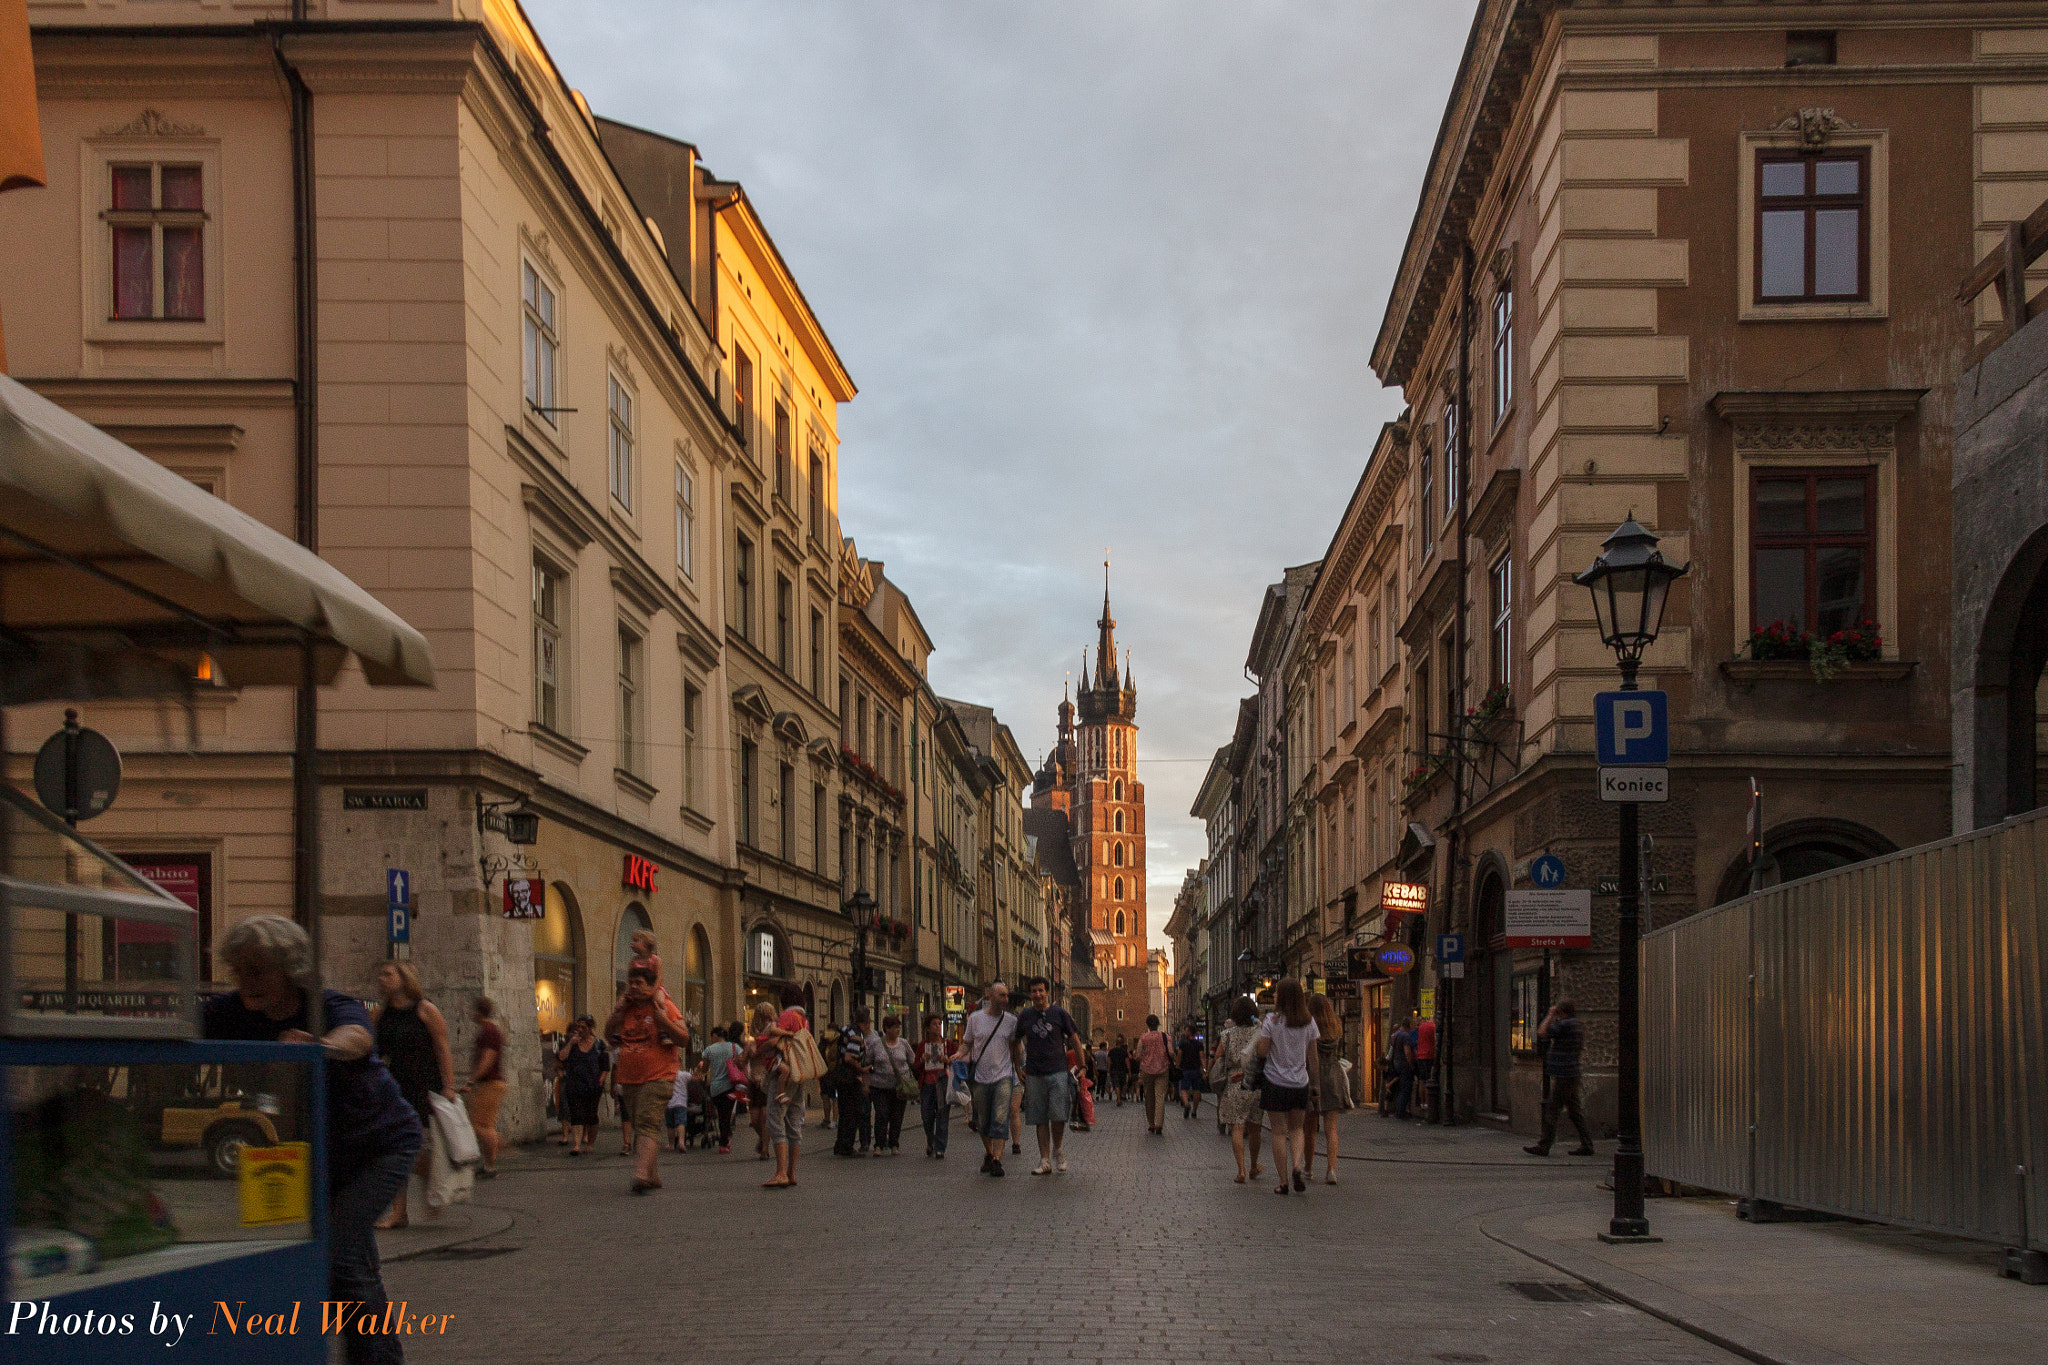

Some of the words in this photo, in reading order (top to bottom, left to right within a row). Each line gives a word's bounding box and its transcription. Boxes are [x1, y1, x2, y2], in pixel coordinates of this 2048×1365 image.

[1613, 700, 1652, 755] P
[1606, 777, 1663, 792] Koniec
[372, 796, 422, 807] MARKA
[629, 854, 659, 892] KFC
[1383, 882, 1427, 901] KEBAB
[1382, 898, 1426, 909] ZAPIEKANKI
[392, 909, 405, 937] P
[1443, 937, 1458, 958] P
[1531, 937, 1556, 946] Strefa
[1559, 937, 1566, 945] A
[39, 995, 86, 1006] JEWH
[88, 995, 147, 1007] QUARTER
